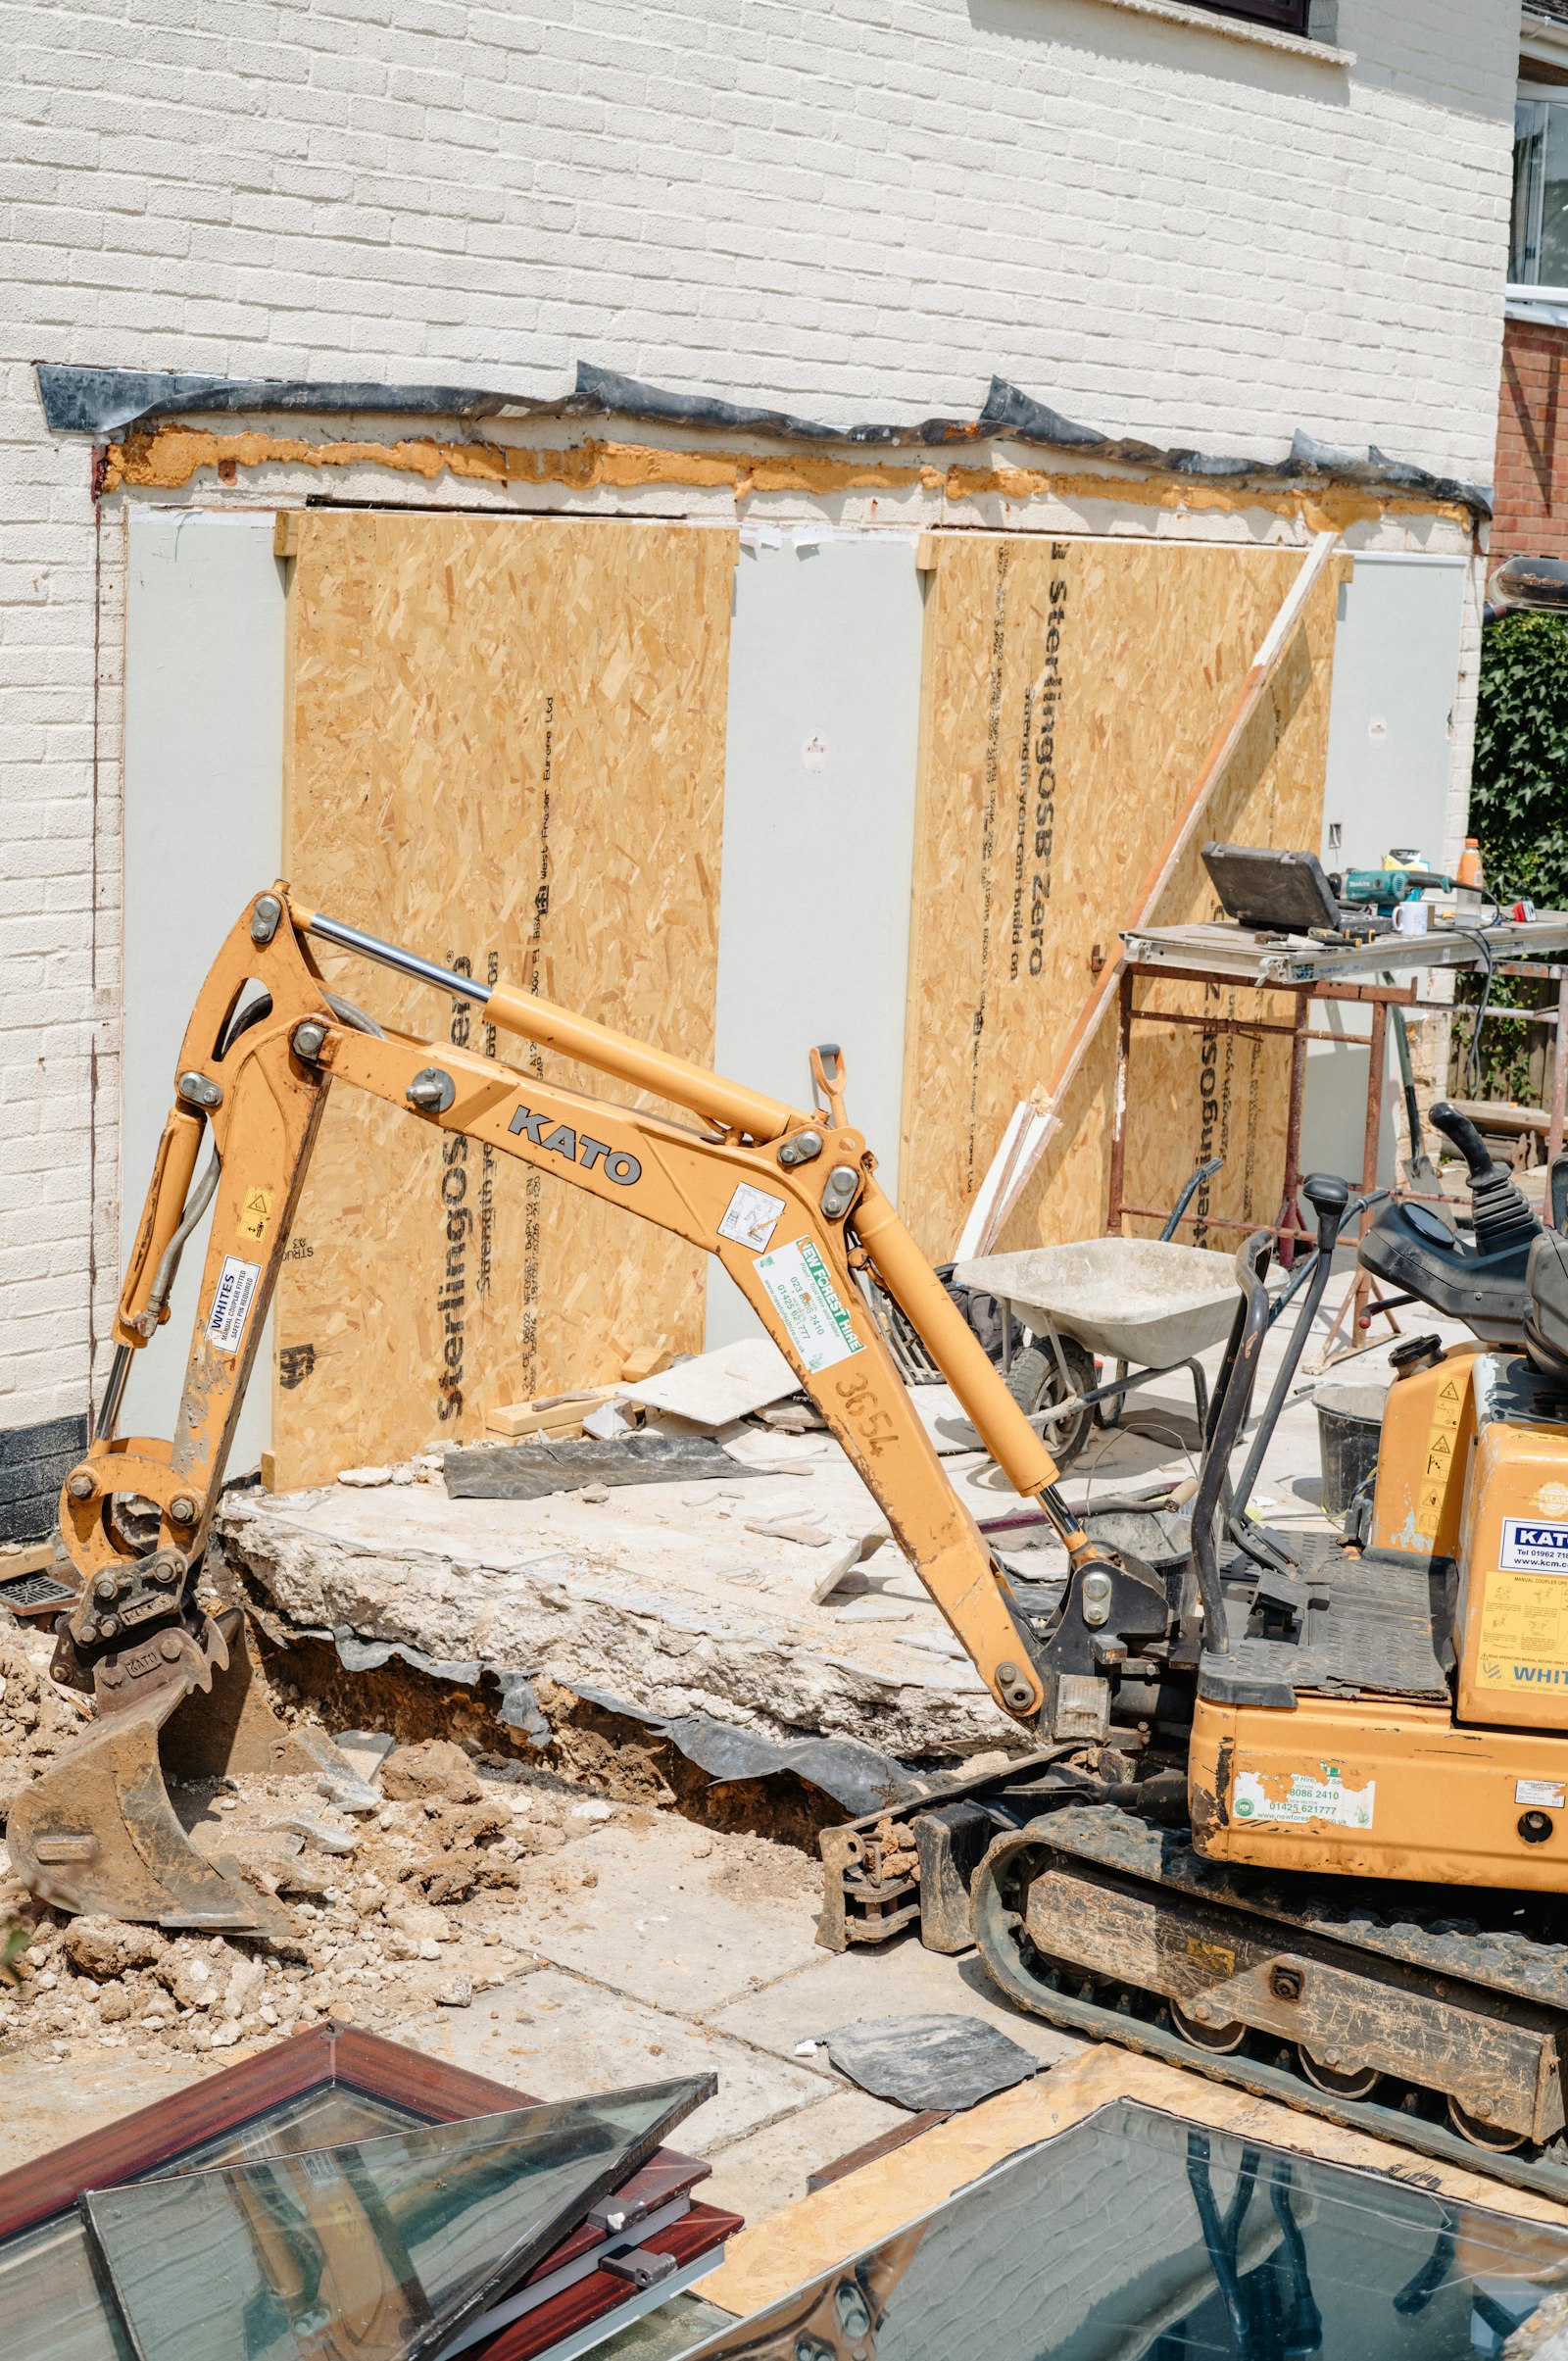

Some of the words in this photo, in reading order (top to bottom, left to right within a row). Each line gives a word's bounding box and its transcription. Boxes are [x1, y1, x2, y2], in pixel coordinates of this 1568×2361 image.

[544, 697, 554, 724] Ltd
[542, 730, 552, 781] Europe
[1018, 687, 1035, 787] Strength
[540, 789, 550, 838] Fraser
[1015, 793, 1029, 837] you
[540, 846, 549, 880] West
[1013, 842, 1026, 881] can
[1010, 887, 1025, 946] build
[1027, 873, 1052, 978] Zero
[1008, 950, 1021, 982] on
[507, 1105, 644, 1187] KATO
[525, 1178, 533, 1196] EN
[476, 1179, 496, 1294] Strength
[436, 1127, 473, 1422] SterlingOS
[777, 1284, 796, 1310] 01425
[797, 1238, 824, 1269] NEW
[812, 1265, 851, 1320] FOREST
[838, 1319, 865, 1353] HIRE
[211, 1273, 235, 1329] WHITES
[220, 1317, 233, 1342] MANUAL
[227, 1289, 241, 1317] COUPLER
[235, 1269, 247, 1291] FITTED
[230, 1317, 242, 1339] SAFETY
[236, 1306, 245, 1318] PIN
[241, 1277, 254, 1307] REQUIRED
[764, 1279, 806, 1354] www.newforesthire.co.uk
[790, 1275, 804, 1293] 023
[810, 1314, 826, 1337] 2410
[799, 1261, 810, 1279] Plant
[808, 1281, 820, 1298] Tool
[815, 1295, 826, 1309] Hire
[822, 1307, 832, 1321] and
[828, 1320, 841, 1339] Sales
[522, 1311, 531, 1345] 0502
[1514, 1557, 1568, 1568] www.kcm.c
[1519, 1530, 1568, 1548] KAT
[1531, 1549, 1554, 1558] 01962
[127, 1651, 158, 1674] KATO
[1269, 1802, 1298, 1813] 01425
[1300, 1803, 1337, 1815] 621777
[1290, 1788, 1313, 1798] 8086
[1315, 1790, 1340, 1800] 2410
